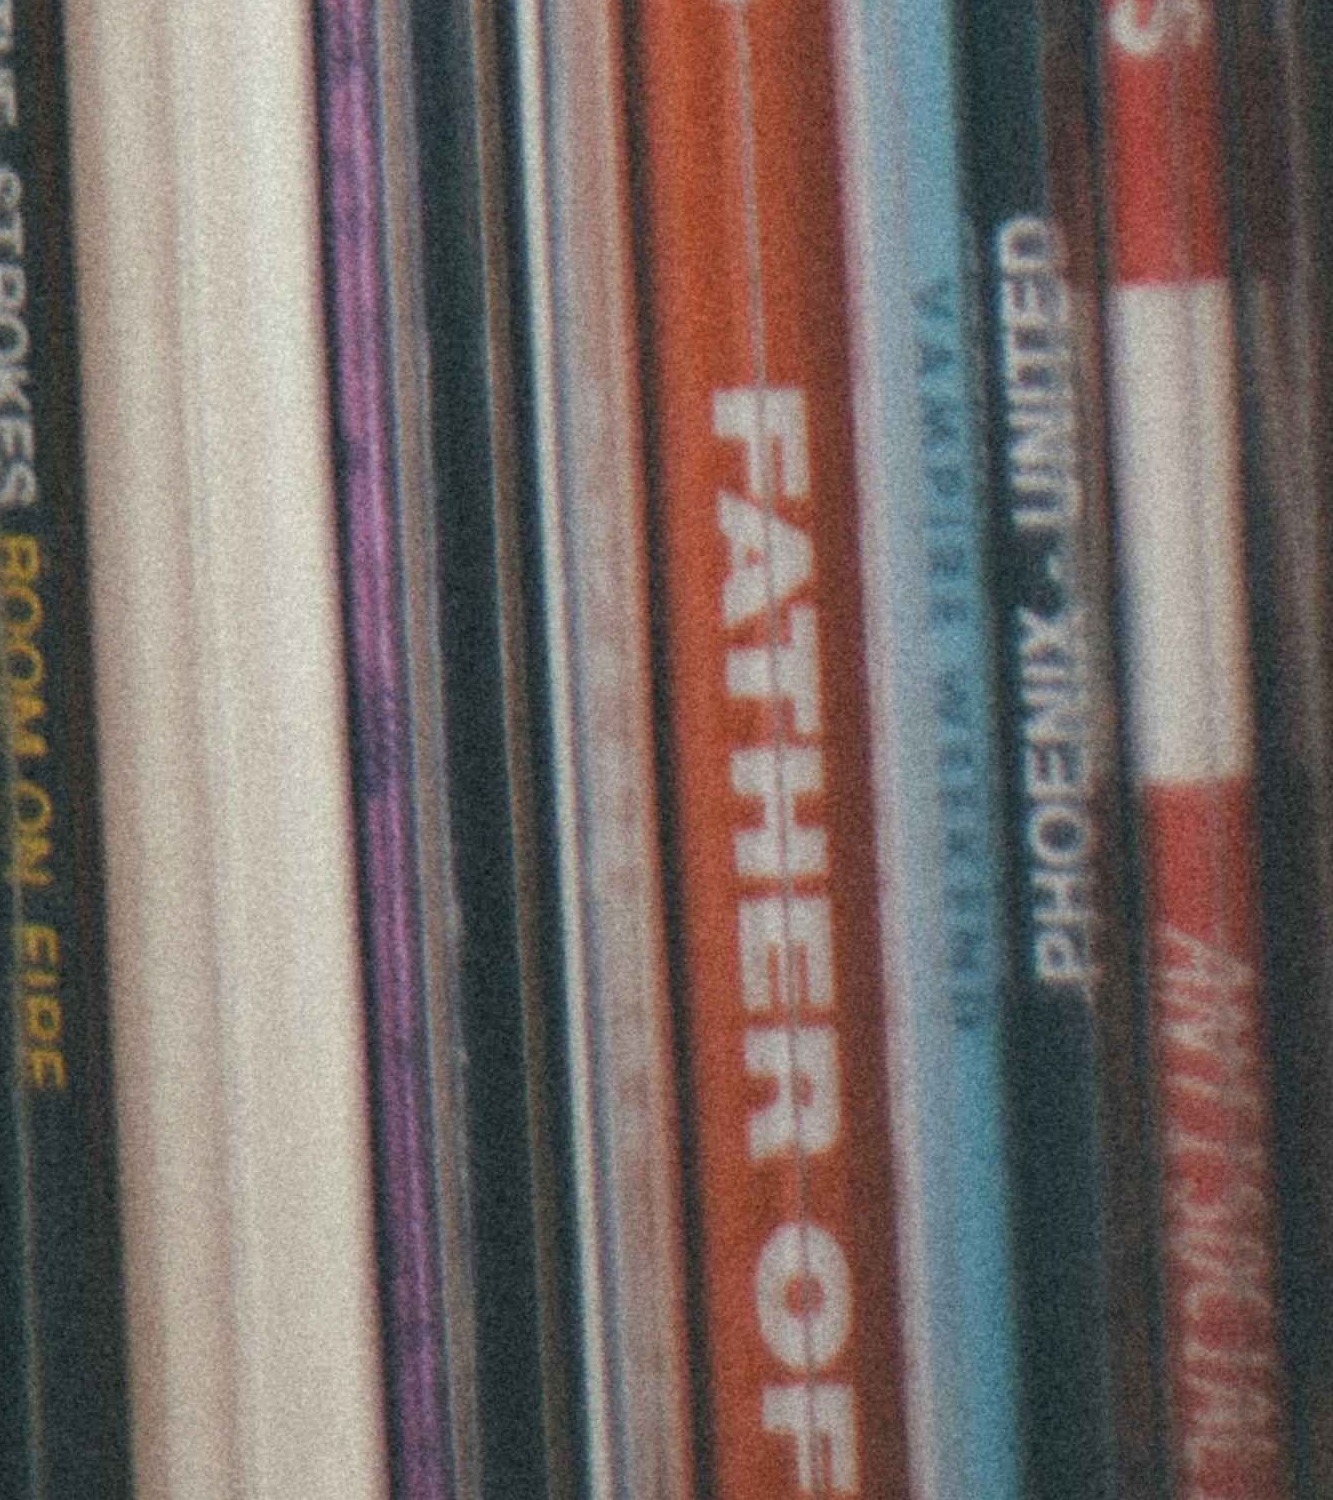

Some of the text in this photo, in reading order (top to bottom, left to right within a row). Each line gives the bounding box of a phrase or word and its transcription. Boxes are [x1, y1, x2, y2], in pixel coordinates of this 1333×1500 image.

[995, 217, 1081, 528] UNITED
[711, 385, 842, 1160] FATHER
[913, 278, 991, 1033] VAMPIRE WEEKEND
[1016, 608, 1102, 983] PHOENIX
[3, 782, 55, 888] ON
[15, 925, 66, 1090] FIRE
[751, 1225, 859, 1495] OF
[1162, 926, 1278, 1500] ANTISOCIAL
